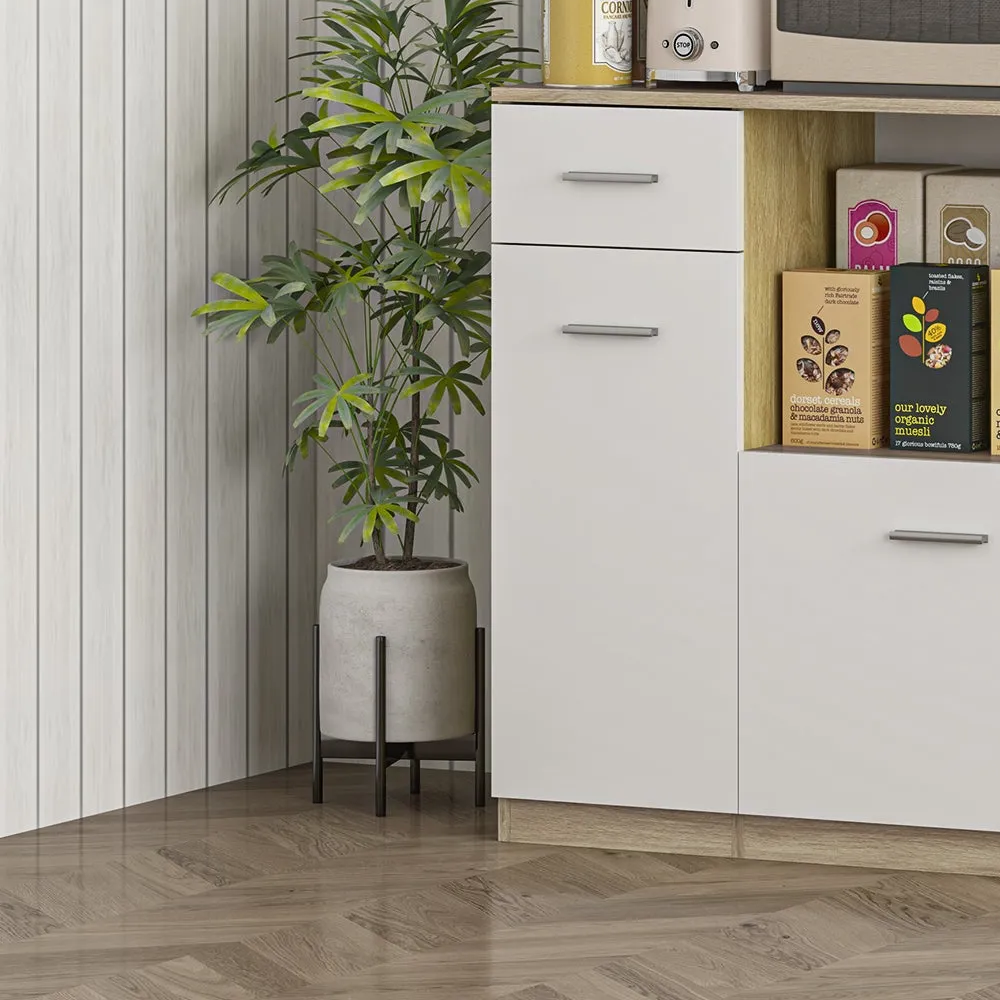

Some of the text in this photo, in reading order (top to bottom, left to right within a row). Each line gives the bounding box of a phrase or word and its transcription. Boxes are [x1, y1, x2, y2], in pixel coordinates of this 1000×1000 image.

[812, 318, 824, 333] new
[790, 394, 861, 407] dorset cereals
[790, 404, 862, 415] chocolate granola
[894, 403, 947, 416] our lovely
[790, 412, 864, 424] & macadamia nuts
[894, 415, 935, 426] organic
[895, 426, 931, 437] muesli
